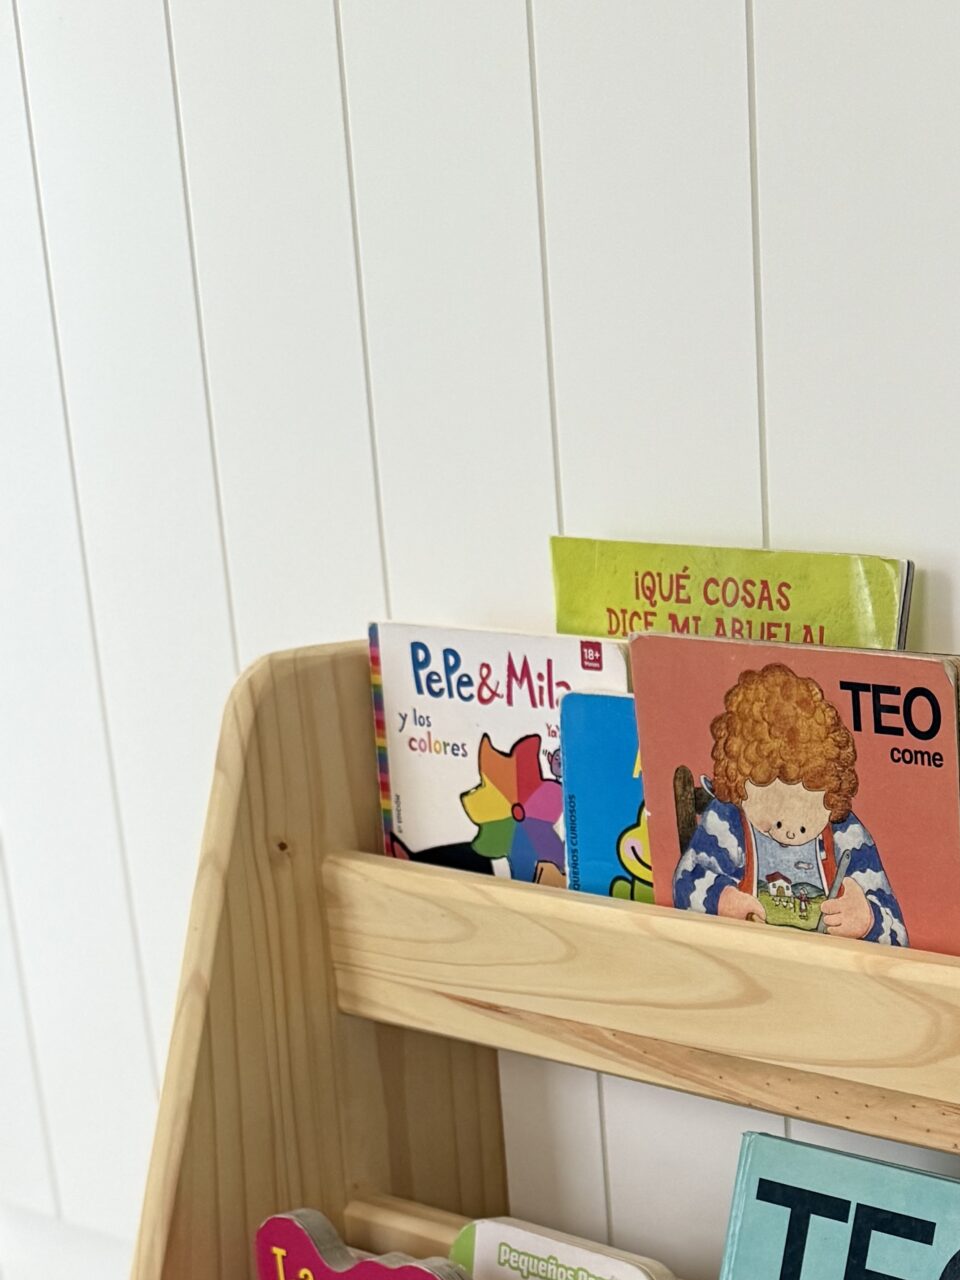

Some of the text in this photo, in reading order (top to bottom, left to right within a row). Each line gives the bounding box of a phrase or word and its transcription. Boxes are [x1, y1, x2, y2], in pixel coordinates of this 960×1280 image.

[635, 566, 792, 611] ¡QUÉ COSAS
[606, 607, 657, 637] DICE
[668, 613, 701, 635] MI
[583, 648, 600, 661] 18+
[398, 708, 431, 733] y los
[839, 681, 941, 740] TEO
[408, 731, 468, 757] colores
[890, 747, 944, 768] come
[568, 794, 578, 846] CURIOSOS
[499, 1243, 575, 1279] Pequeños
